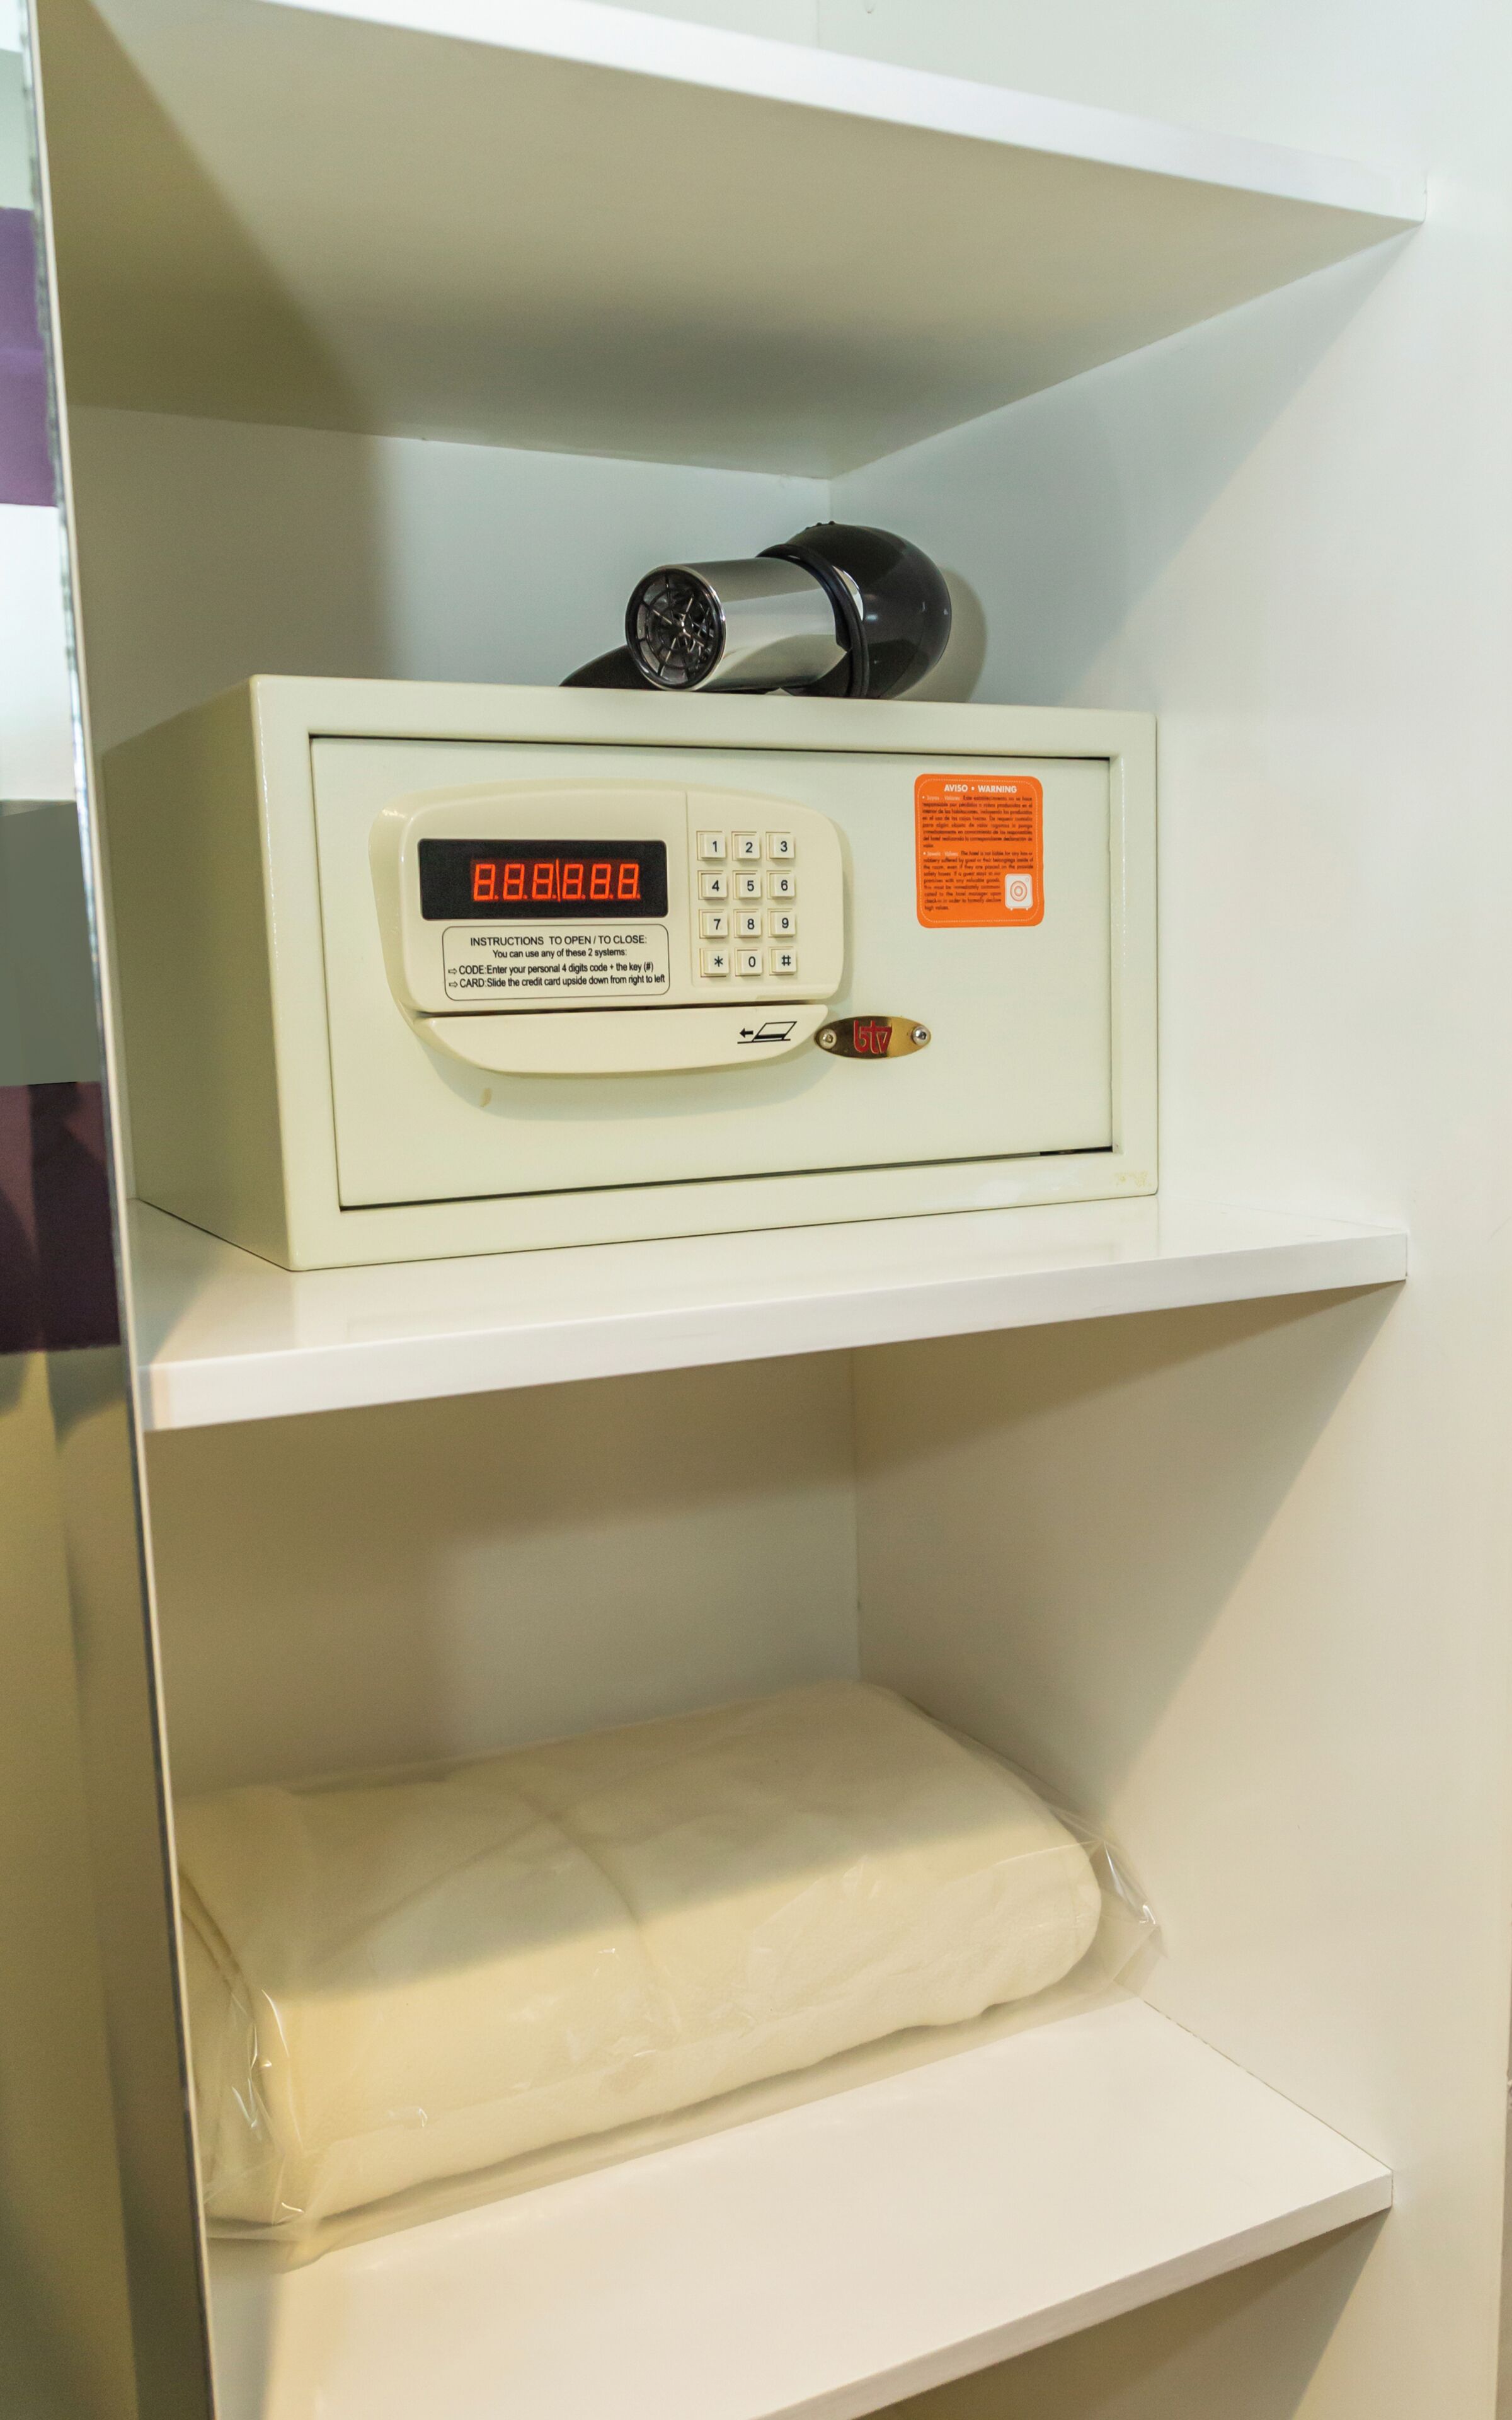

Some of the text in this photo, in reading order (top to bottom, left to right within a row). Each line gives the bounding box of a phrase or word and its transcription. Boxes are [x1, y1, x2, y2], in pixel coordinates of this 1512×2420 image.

[944, 784, 968, 792] AVISO
[713, 841, 717, 852] 1
[746, 842, 752, 853] 2
[781, 841, 788, 852] 3
[712, 880, 719, 891] 4
[747, 880, 754, 891] 5
[781, 880, 788, 890] 6
[714, 919, 721, 930] 7
[747, 919, 754, 930] 8
[782, 918, 789, 928] 9
[471, 935, 646, 946] INSTRUCTIONS TO OPEN / TO CLOSE:
[493, 950, 507, 958] You
[595, 948, 627, 957] systems:
[782, 955, 791, 966] #
[509, 967, 525, 975] your
[528, 964, 560, 975] personal
[562, 964, 566, 972] 4
[568, 964, 588, 974] digits
[590, 963, 607, 972] code
[616, 963, 627, 971] the
[629, 962, 641, 973] key
[644, 962, 653, 972] (#)
[508, 978, 520, 986] the
[522, 977, 542, 986] credit
[544, 977, 560, 986] card
[563, 976, 587, 987] upside
[589, 976, 609, 984] down
[610, 976, 626, 984] from
[629, 975, 644, 986] right
[655, 974, 665, 982] left
[854, 1020, 892, 1054] btv
